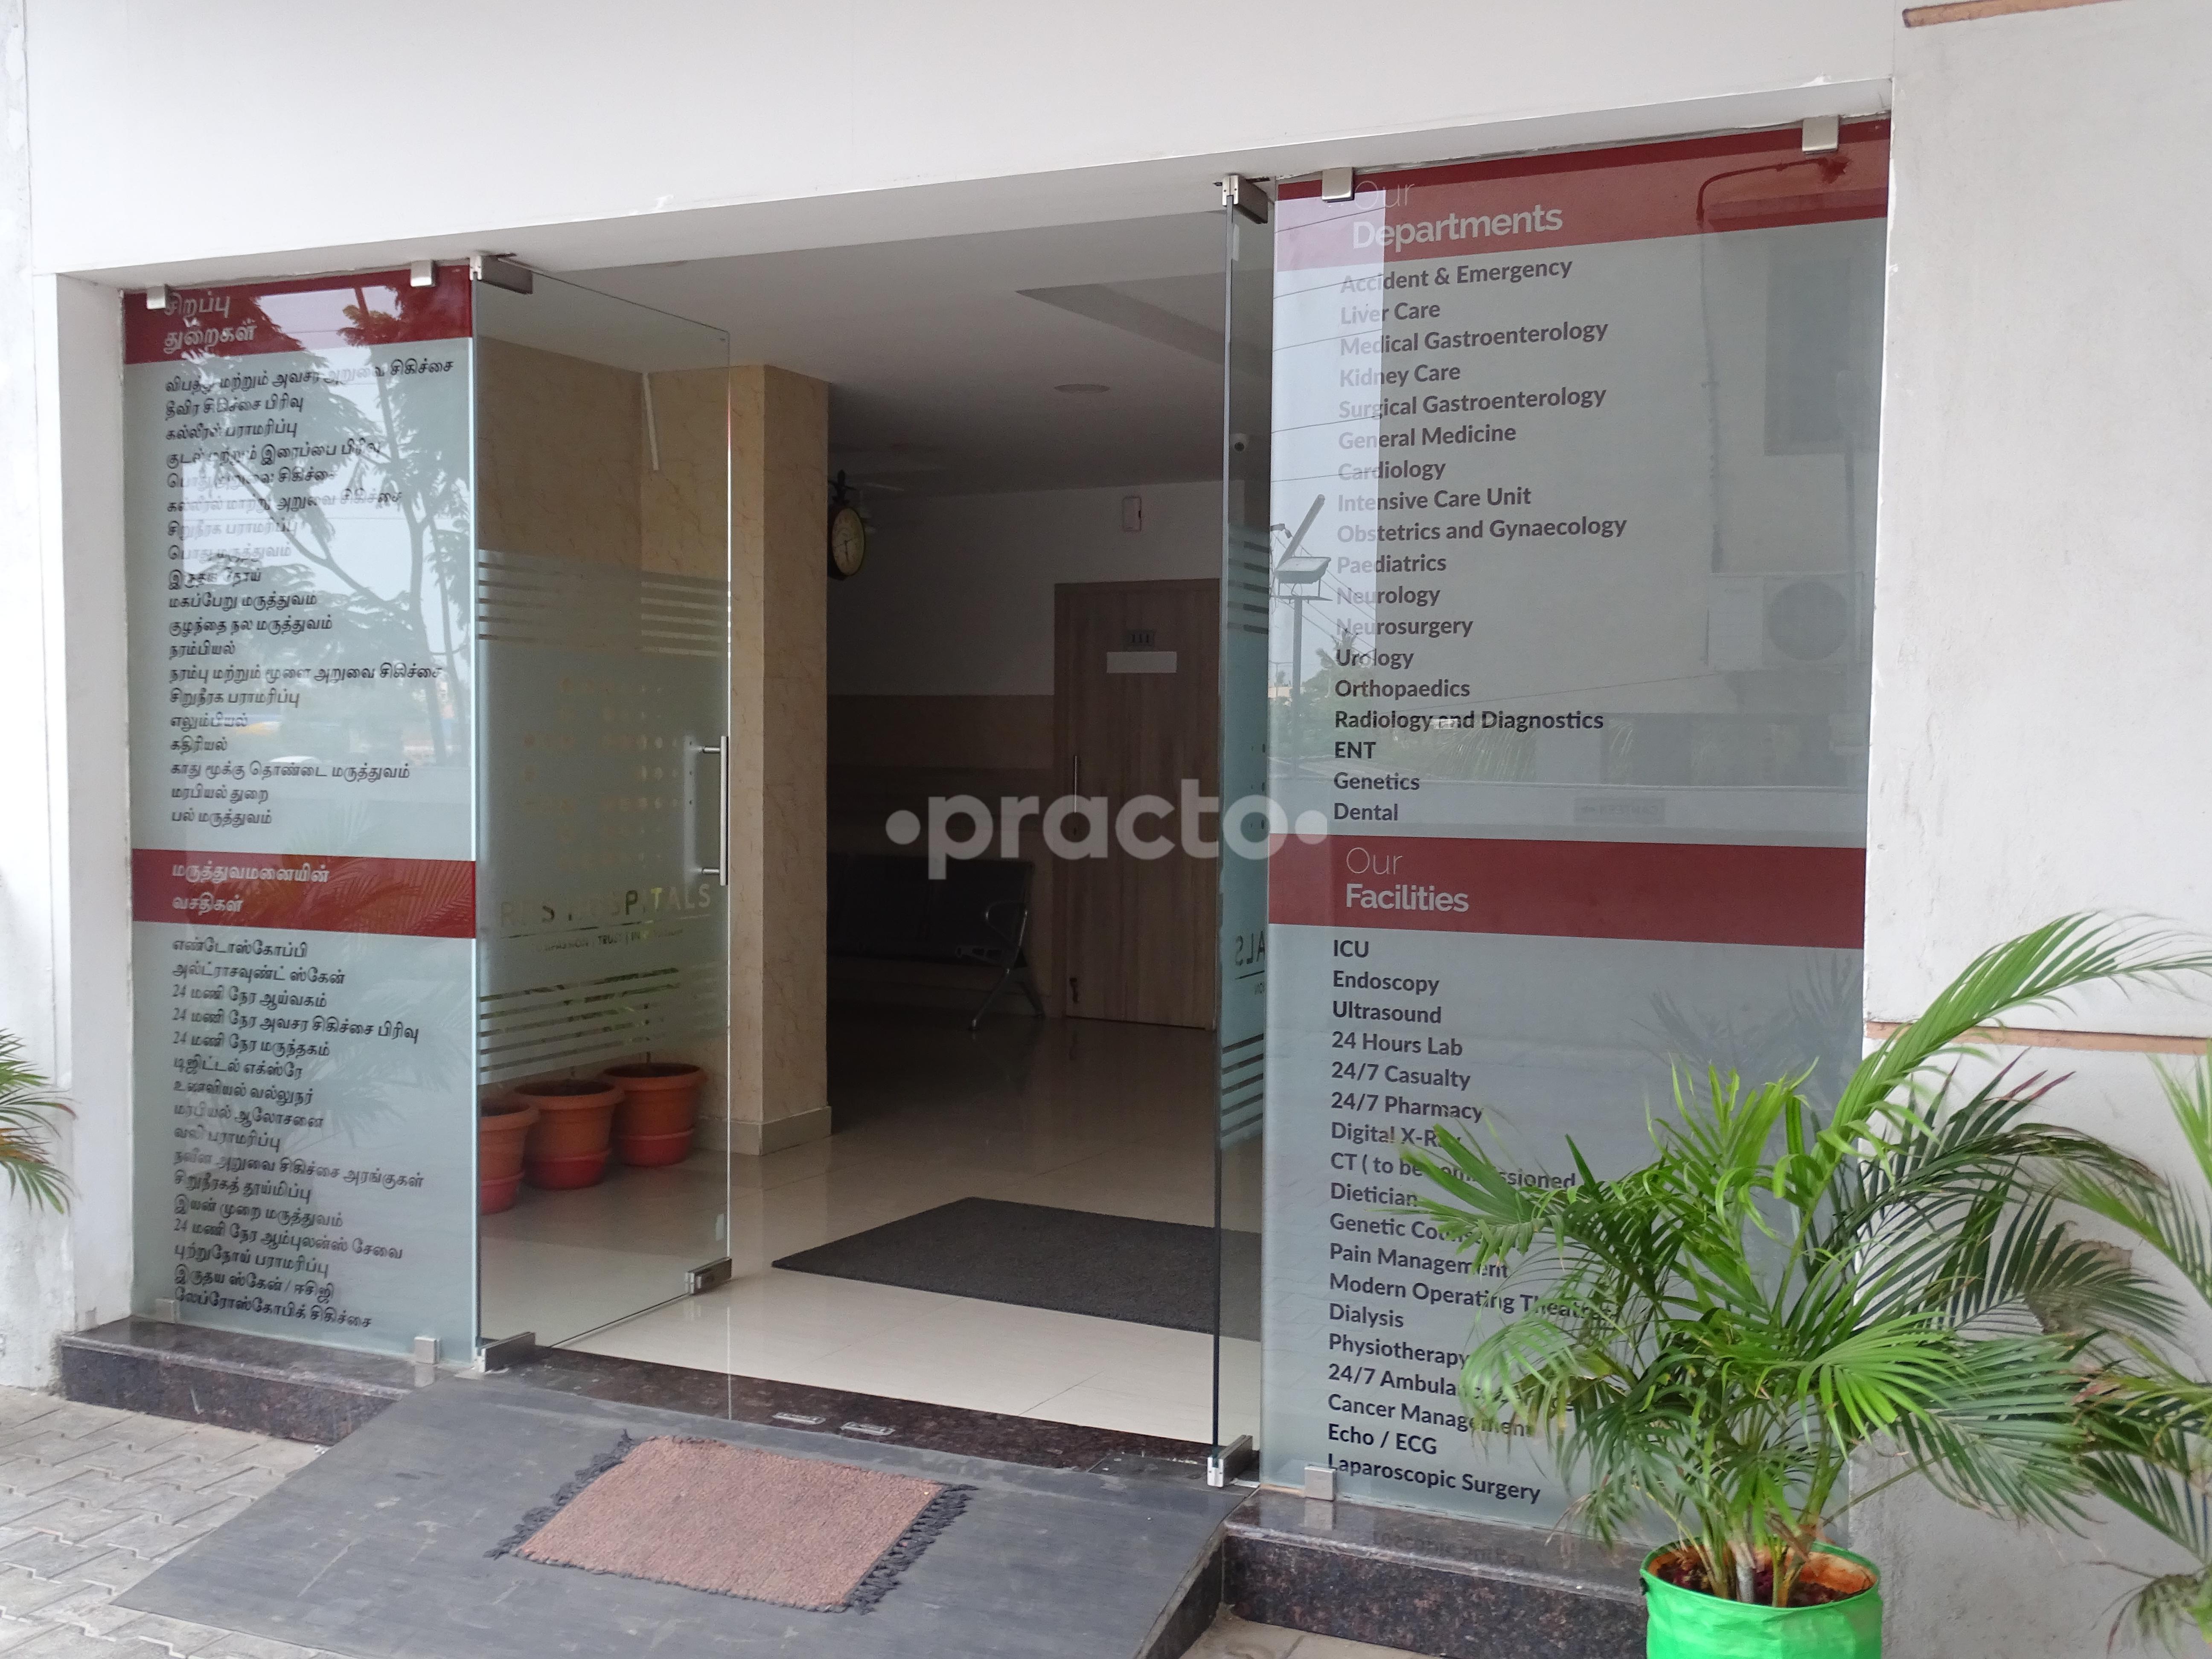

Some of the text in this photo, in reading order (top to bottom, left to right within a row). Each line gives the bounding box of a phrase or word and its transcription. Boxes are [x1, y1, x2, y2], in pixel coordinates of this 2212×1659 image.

[1353, 181, 1415, 209] Our
[1353, 204, 1563, 252] Departments
[1340, 259, 1573, 294] Accident & Emergency
[1341, 301, 1441, 325] Liver Care
[1340, 321, 1608, 356] Medical Gastroenterology
[390, 358, 454, 376] சிகிச்சை
[1340, 363, 1461, 387] Kidney Care
[265, 393, 303, 413] பிரிவு
[1339, 386, 1607, 419] Surgical Gastroenterology
[1339, 424, 1516, 450] General Medicine
[1338, 460, 1447, 481] Cardiology
[1338, 486, 1532, 512] Intensive Care Unit
[1338, 516, 1627, 543] Obstetrics and Gynaecology
[1337, 554, 1447, 574] Paediatrics
[1336, 585, 1441, 607] Neurology
[257, 614, 332, 635] மருத்துவம்
[1336, 617, 1474, 638] Neurosurgery
[1336, 649, 1414, 670] Urology
[213, 664, 261, 684] மற்றும்
[228, 687, 300, 708] பராமரிப்பு
[1335, 679, 1470, 701] Orthopaedics
[1334, 710, 1604, 733] Radiology and Diagnostics
[1334, 741, 1376, 759] ENT
[332, 762, 410, 783] மருத்துவம்
[1333, 772, 1420, 791] Genetics
[198, 808, 273, 828] மருத்துவம்
[1333, 803, 1399, 821] Dental
[1346, 847, 1403, 875] Our
[1345, 883, 1470, 914] Facilities
[1333, 939, 1370, 958] ICU
[172, 984, 187, 998] 24
[1332, 970, 1441, 996] Endoscopy
[1332, 1000, 1442, 1024] Ultrasound
[172, 1007, 187, 1022] 24
[259, 1016, 309, 1033] அவசர
[312, 1015, 375, 1036] சிகிச்சை
[378, 1020, 419, 1045] பிரிவு
[172, 1030, 188, 1045] 24
[1331, 1031, 1463, 1057] 24 Hours Lab
[1331, 1061, 1471, 1091] 24/7 Casualty
[1331, 1091, 1484, 1123] 24/7 Pharmacy
[1330, 1121, 1461, 1149] Digital X-R
[1330, 1152, 1358, 1170] CT
[1373, 1155, 1394, 1176] to
[1330, 1182, 1418, 1207] Dietician
[173, 1218, 188, 1232] 24
[265, 1206, 343, 1228] மருத்துவம்
[1329, 1213, 1406, 1237] Genetic
[1330, 1242, 1371, 1263] Pain
[255, 1254, 329, 1279] பராமரிப்பு
[1329, 1272, 1515, 1315] Modern Operating
[310, 1304, 372, 1327] சிகிச்சை
[1329, 1302, 1404, 1328] Dialysis
[1328, 1363, 1376, 1385] 24/7
[1328, 1393, 1396, 1419] Cancer
[1328, 1423, 1374, 1446] Echo
[1395, 1433, 1437, 1455] ECG
[1328, 1453, 1541, 1505] Laparoscopic Surgery
